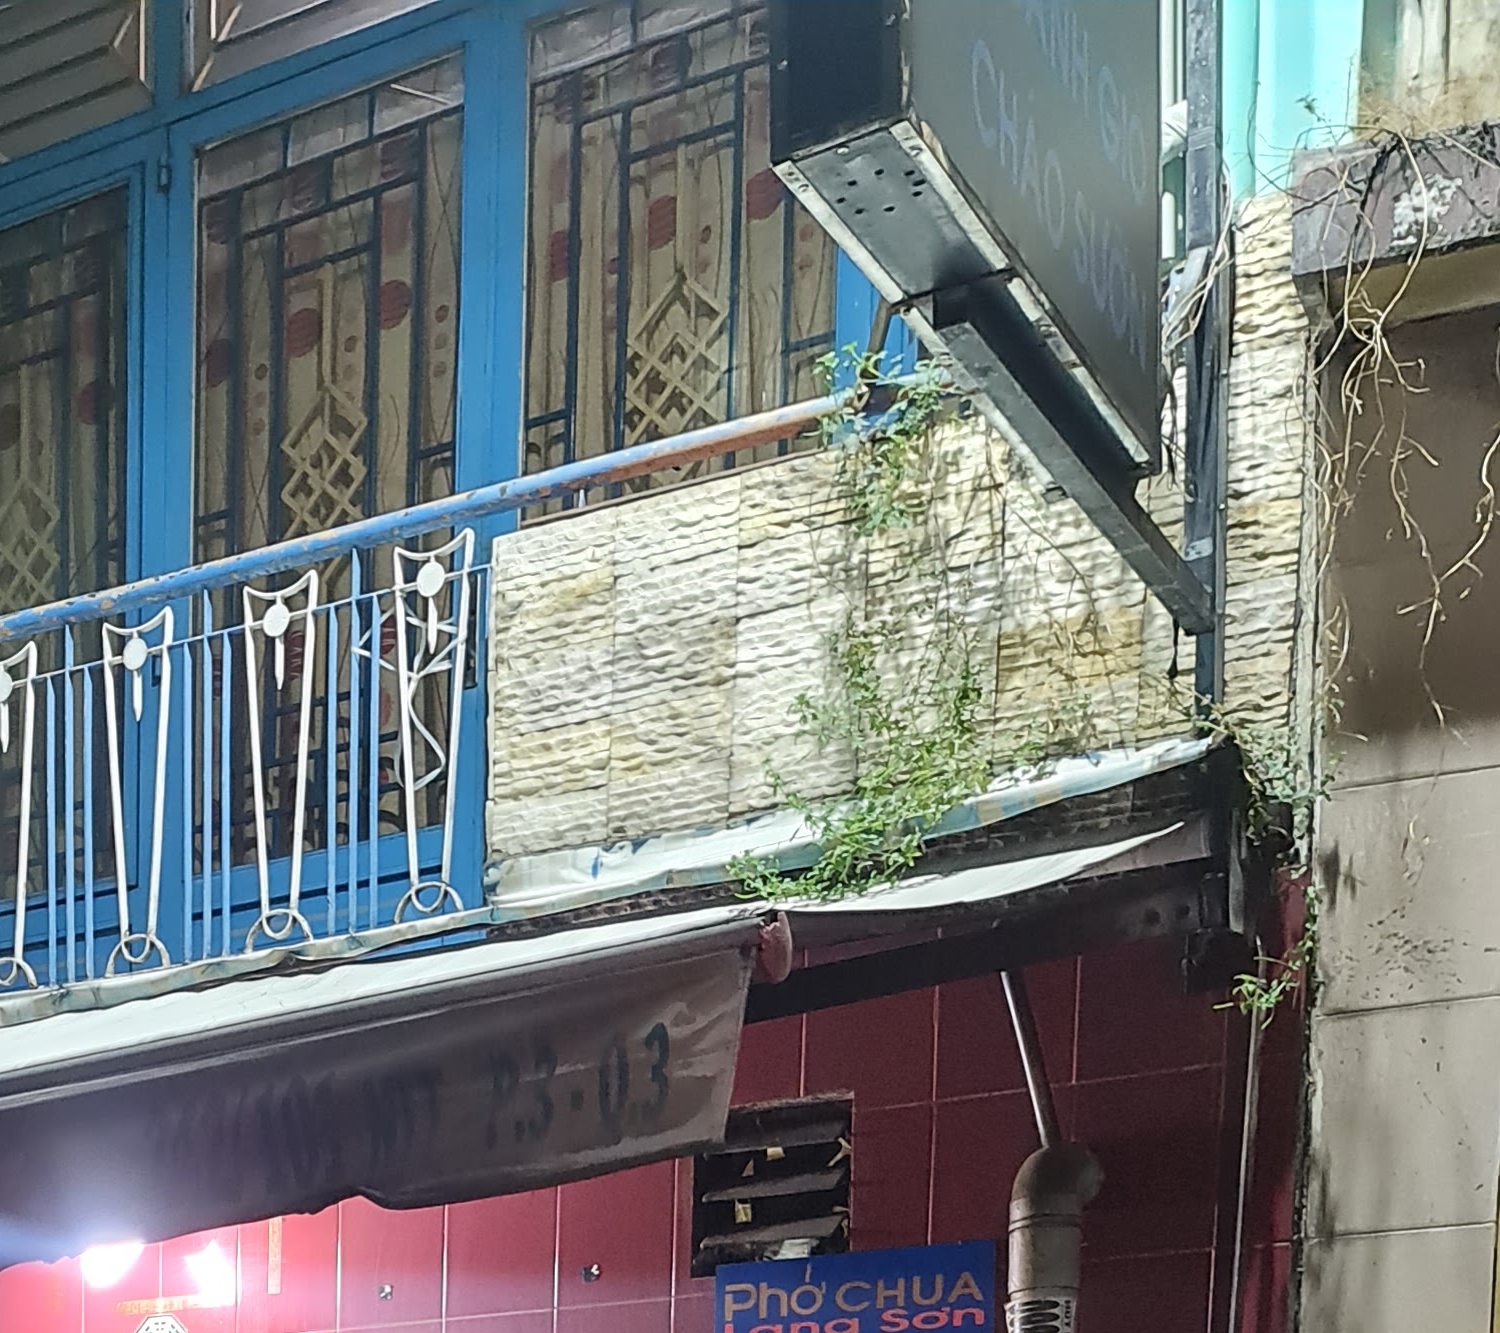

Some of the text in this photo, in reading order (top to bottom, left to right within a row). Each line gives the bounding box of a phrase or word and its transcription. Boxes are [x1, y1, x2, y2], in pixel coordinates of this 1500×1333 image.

[723, 1264, 984, 1322] Phở CHUA
[879, 1305, 985, 1333] Sơn
